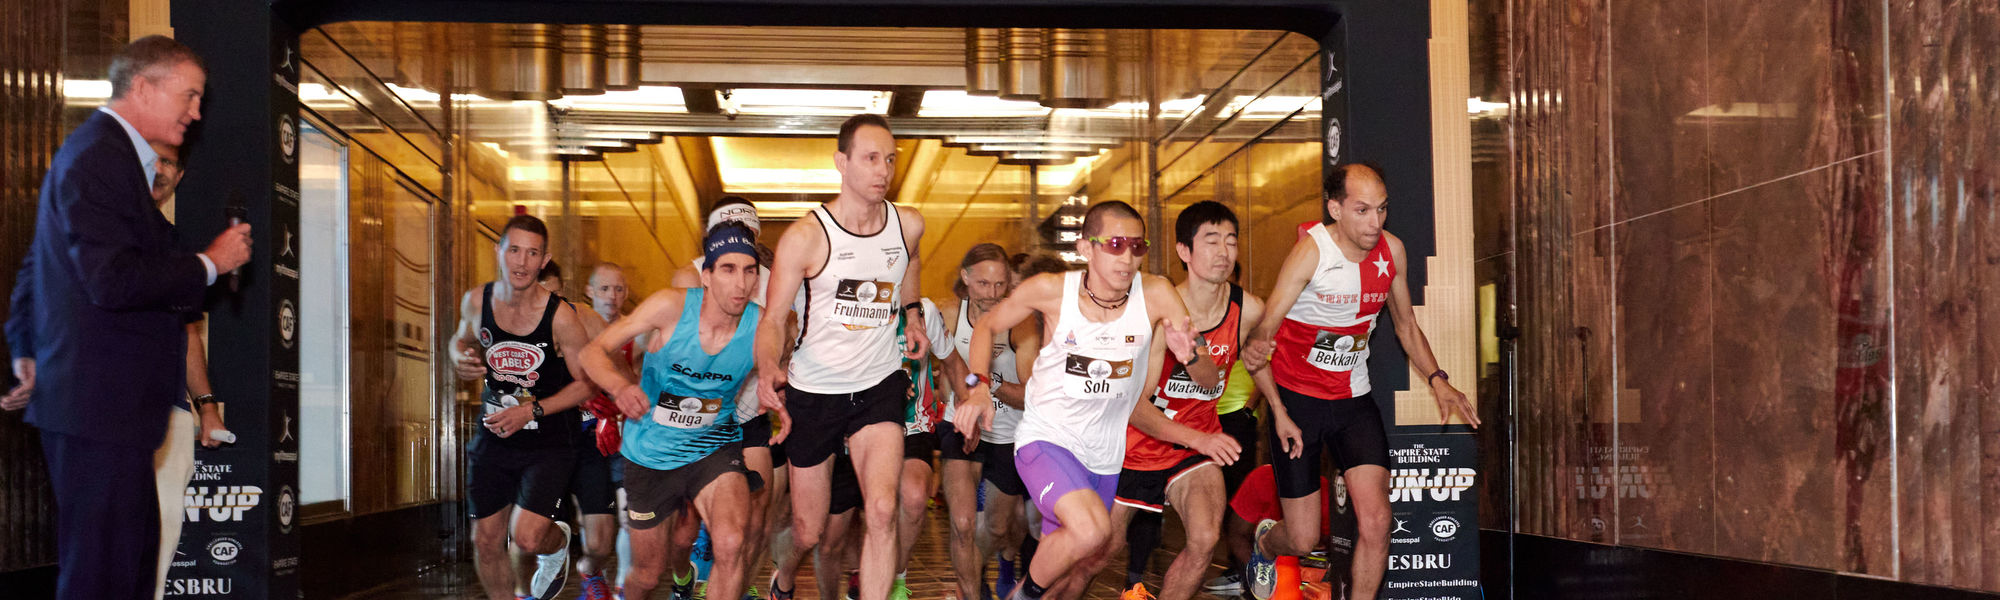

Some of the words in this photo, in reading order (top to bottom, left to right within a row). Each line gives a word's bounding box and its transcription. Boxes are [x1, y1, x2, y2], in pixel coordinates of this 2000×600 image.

[834, 302, 888, 319] Fruhmann
[493, 350, 510, 358] WEST
[1315, 351, 1360, 366] Bekkali
[495, 359, 532, 369] LABELS
[671, 363, 733, 382] SCARPA
[1084, 379, 1110, 394] Soh
[669, 411, 702, 426] Ruga
[1389, 449, 1421, 457] EMPIRE
[1423, 448, 1450, 456] STATE
[1398, 455, 1440, 463] BUILDING
[202, 465, 232, 473] STATE
[1435, 524, 1454, 533] CAF
[213, 546, 235, 556] CAF
[1388, 553, 1451, 570] ESBRU
[1388, 579, 1478, 589] EmpireStateBuilding
